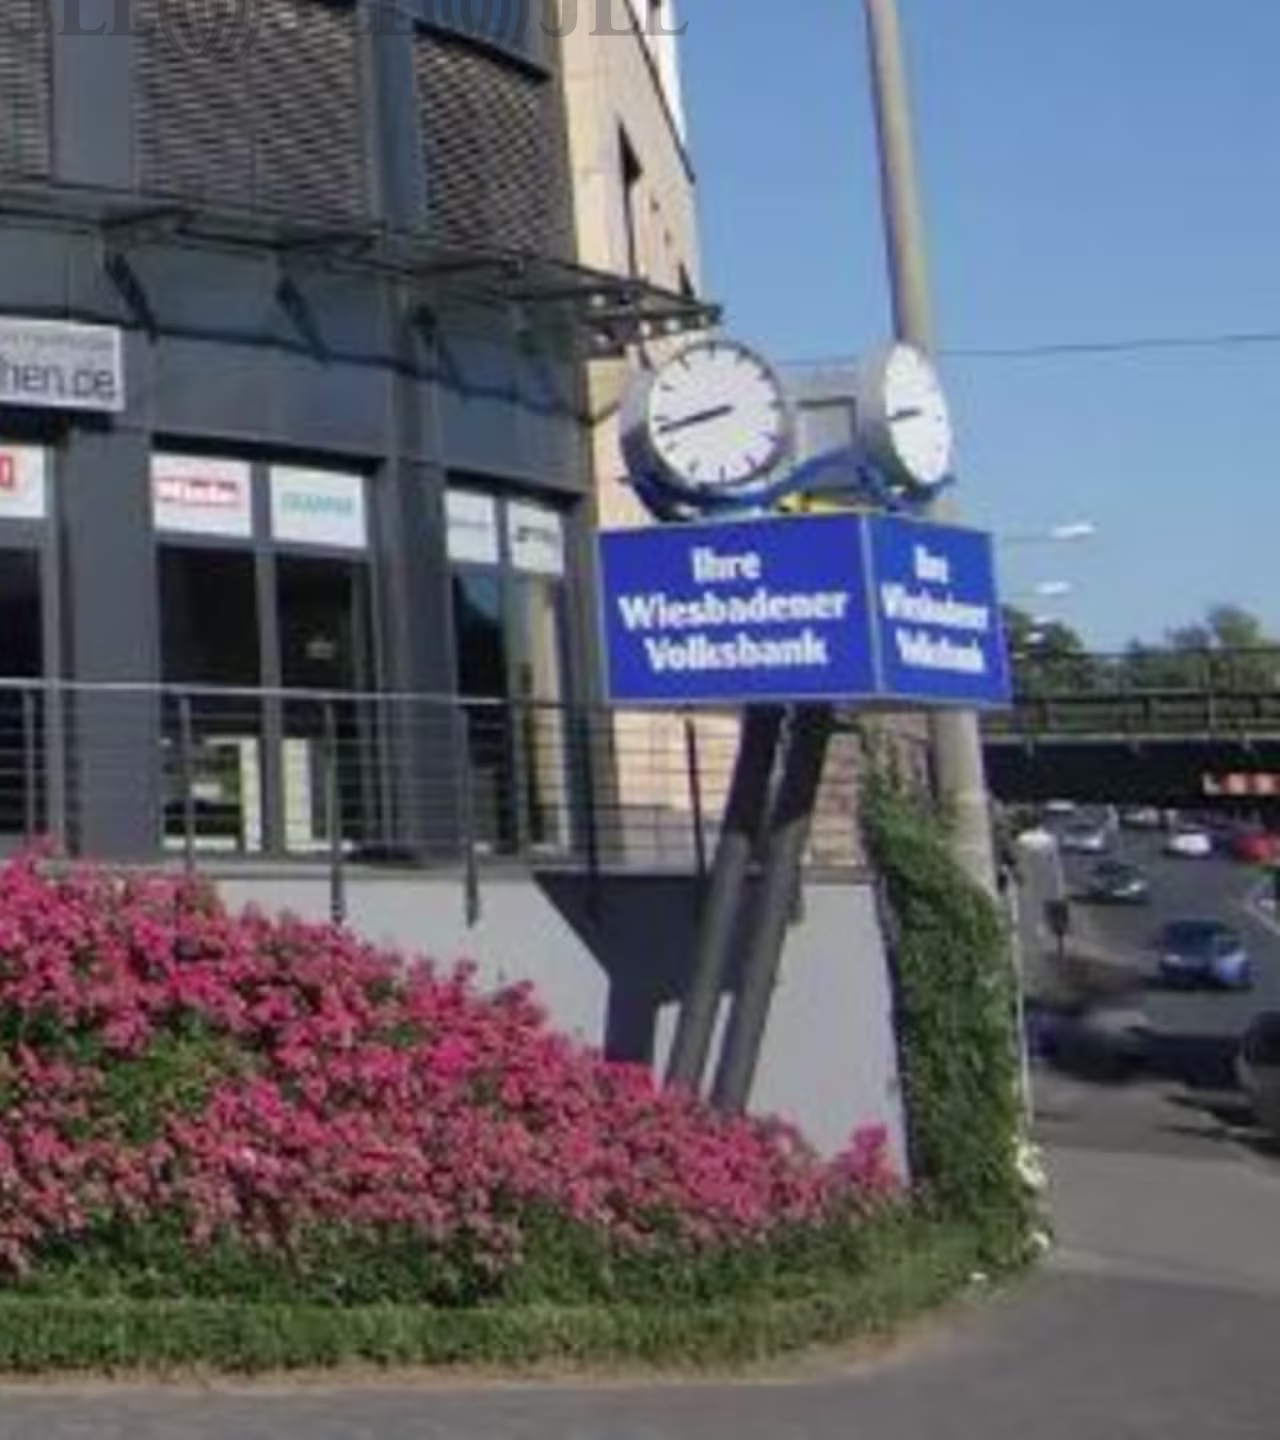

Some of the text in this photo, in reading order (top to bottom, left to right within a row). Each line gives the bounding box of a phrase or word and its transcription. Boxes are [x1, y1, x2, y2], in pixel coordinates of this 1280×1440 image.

[691, 546, 763, 582] Ihre
[618, 589, 850, 630] Wiesbadener
[644, 629, 828, 672] Volksbank
